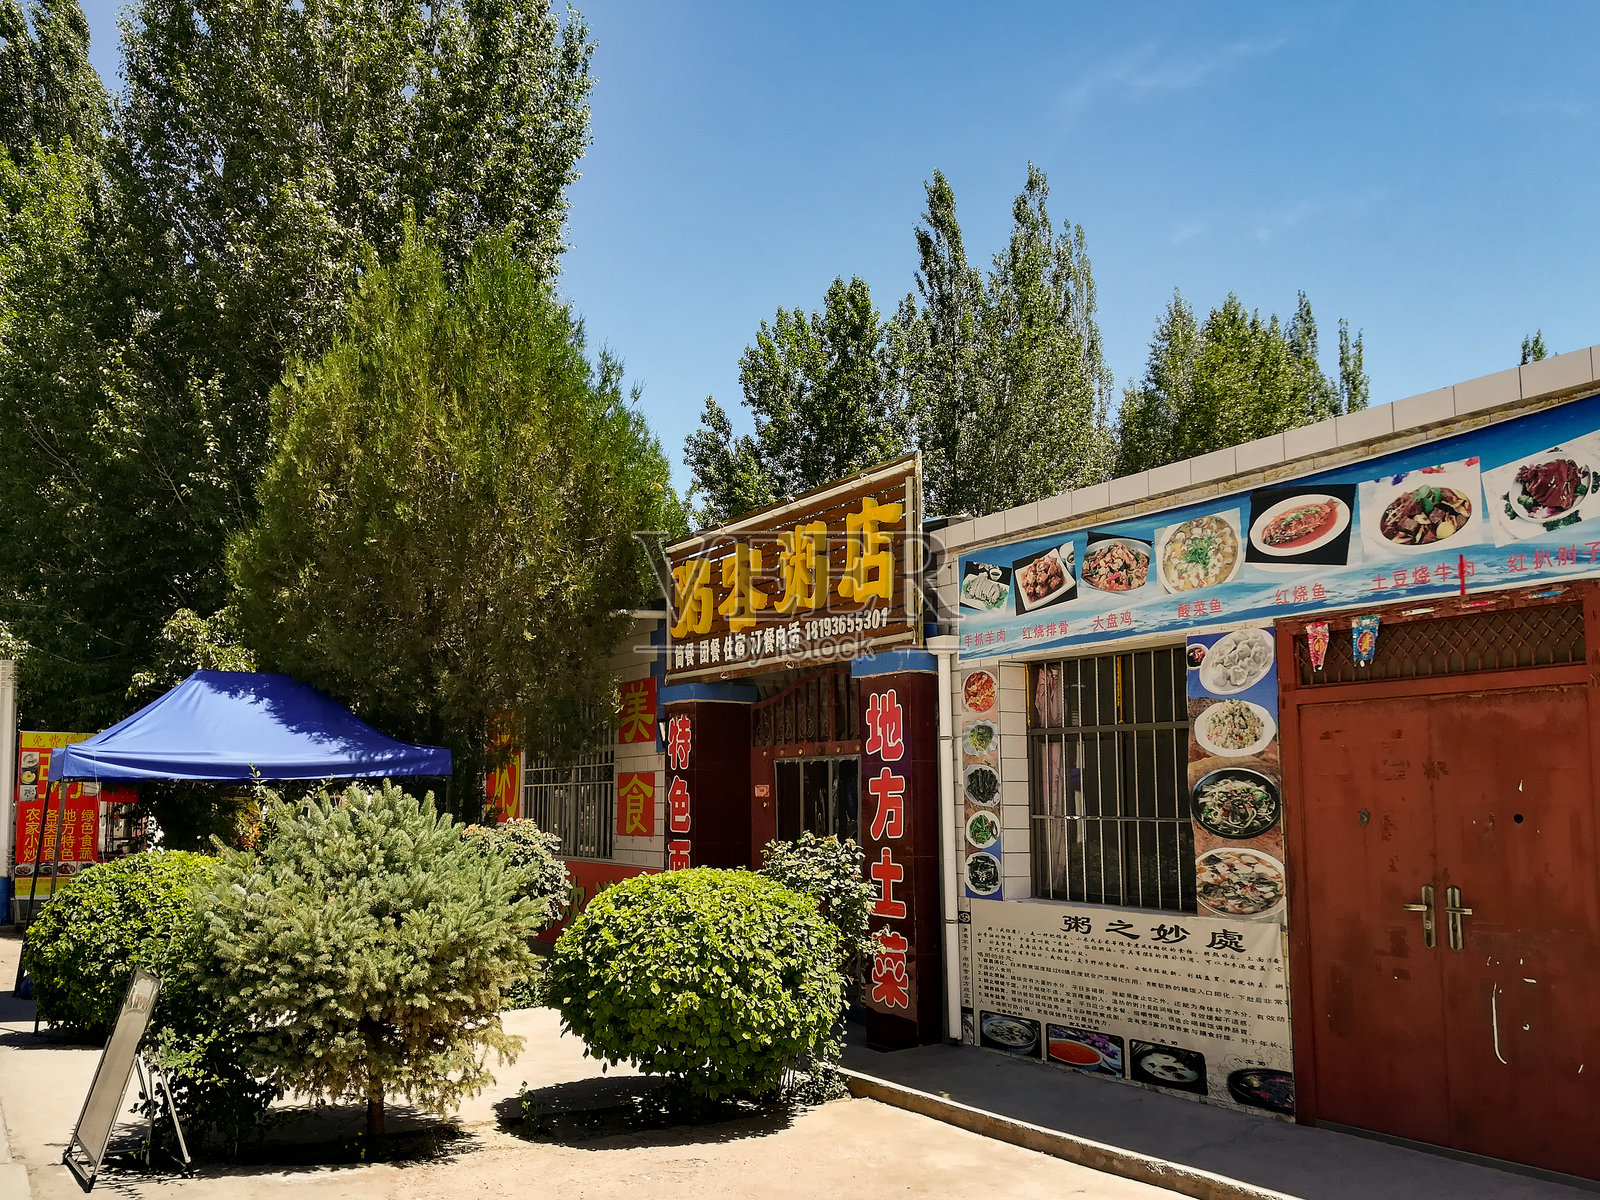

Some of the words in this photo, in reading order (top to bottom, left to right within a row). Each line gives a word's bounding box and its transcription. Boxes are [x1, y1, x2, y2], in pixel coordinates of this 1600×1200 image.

[1177, 598, 1223, 619] 酸菜鱼
[1275, 583, 1327, 606] 红烧鱼
[699, 638, 720, 664] 团餐
[723, 633, 746, 662] 住宿
[751, 620, 800, 655] 订餐电话
[804, 607, 888, 641] 18193655301
[964, 629, 1006, 648] 手抓羊肉
[1022, 622, 1069, 641] 红烧排骨
[1093, 610, 1132, 631] 大盘鸡
[33, 733, 90, 748] 免费停
[24, 808, 41, 862] 农家小炒
[43, 809, 58, 860] 各类面食
[61, 808, 76, 860] 地方特色
[79, 809, 95, 860] 绿色食蔬
[865, 689, 909, 1010] 地方土菜
[1059, 914, 1248, 954] 粥之妙處
